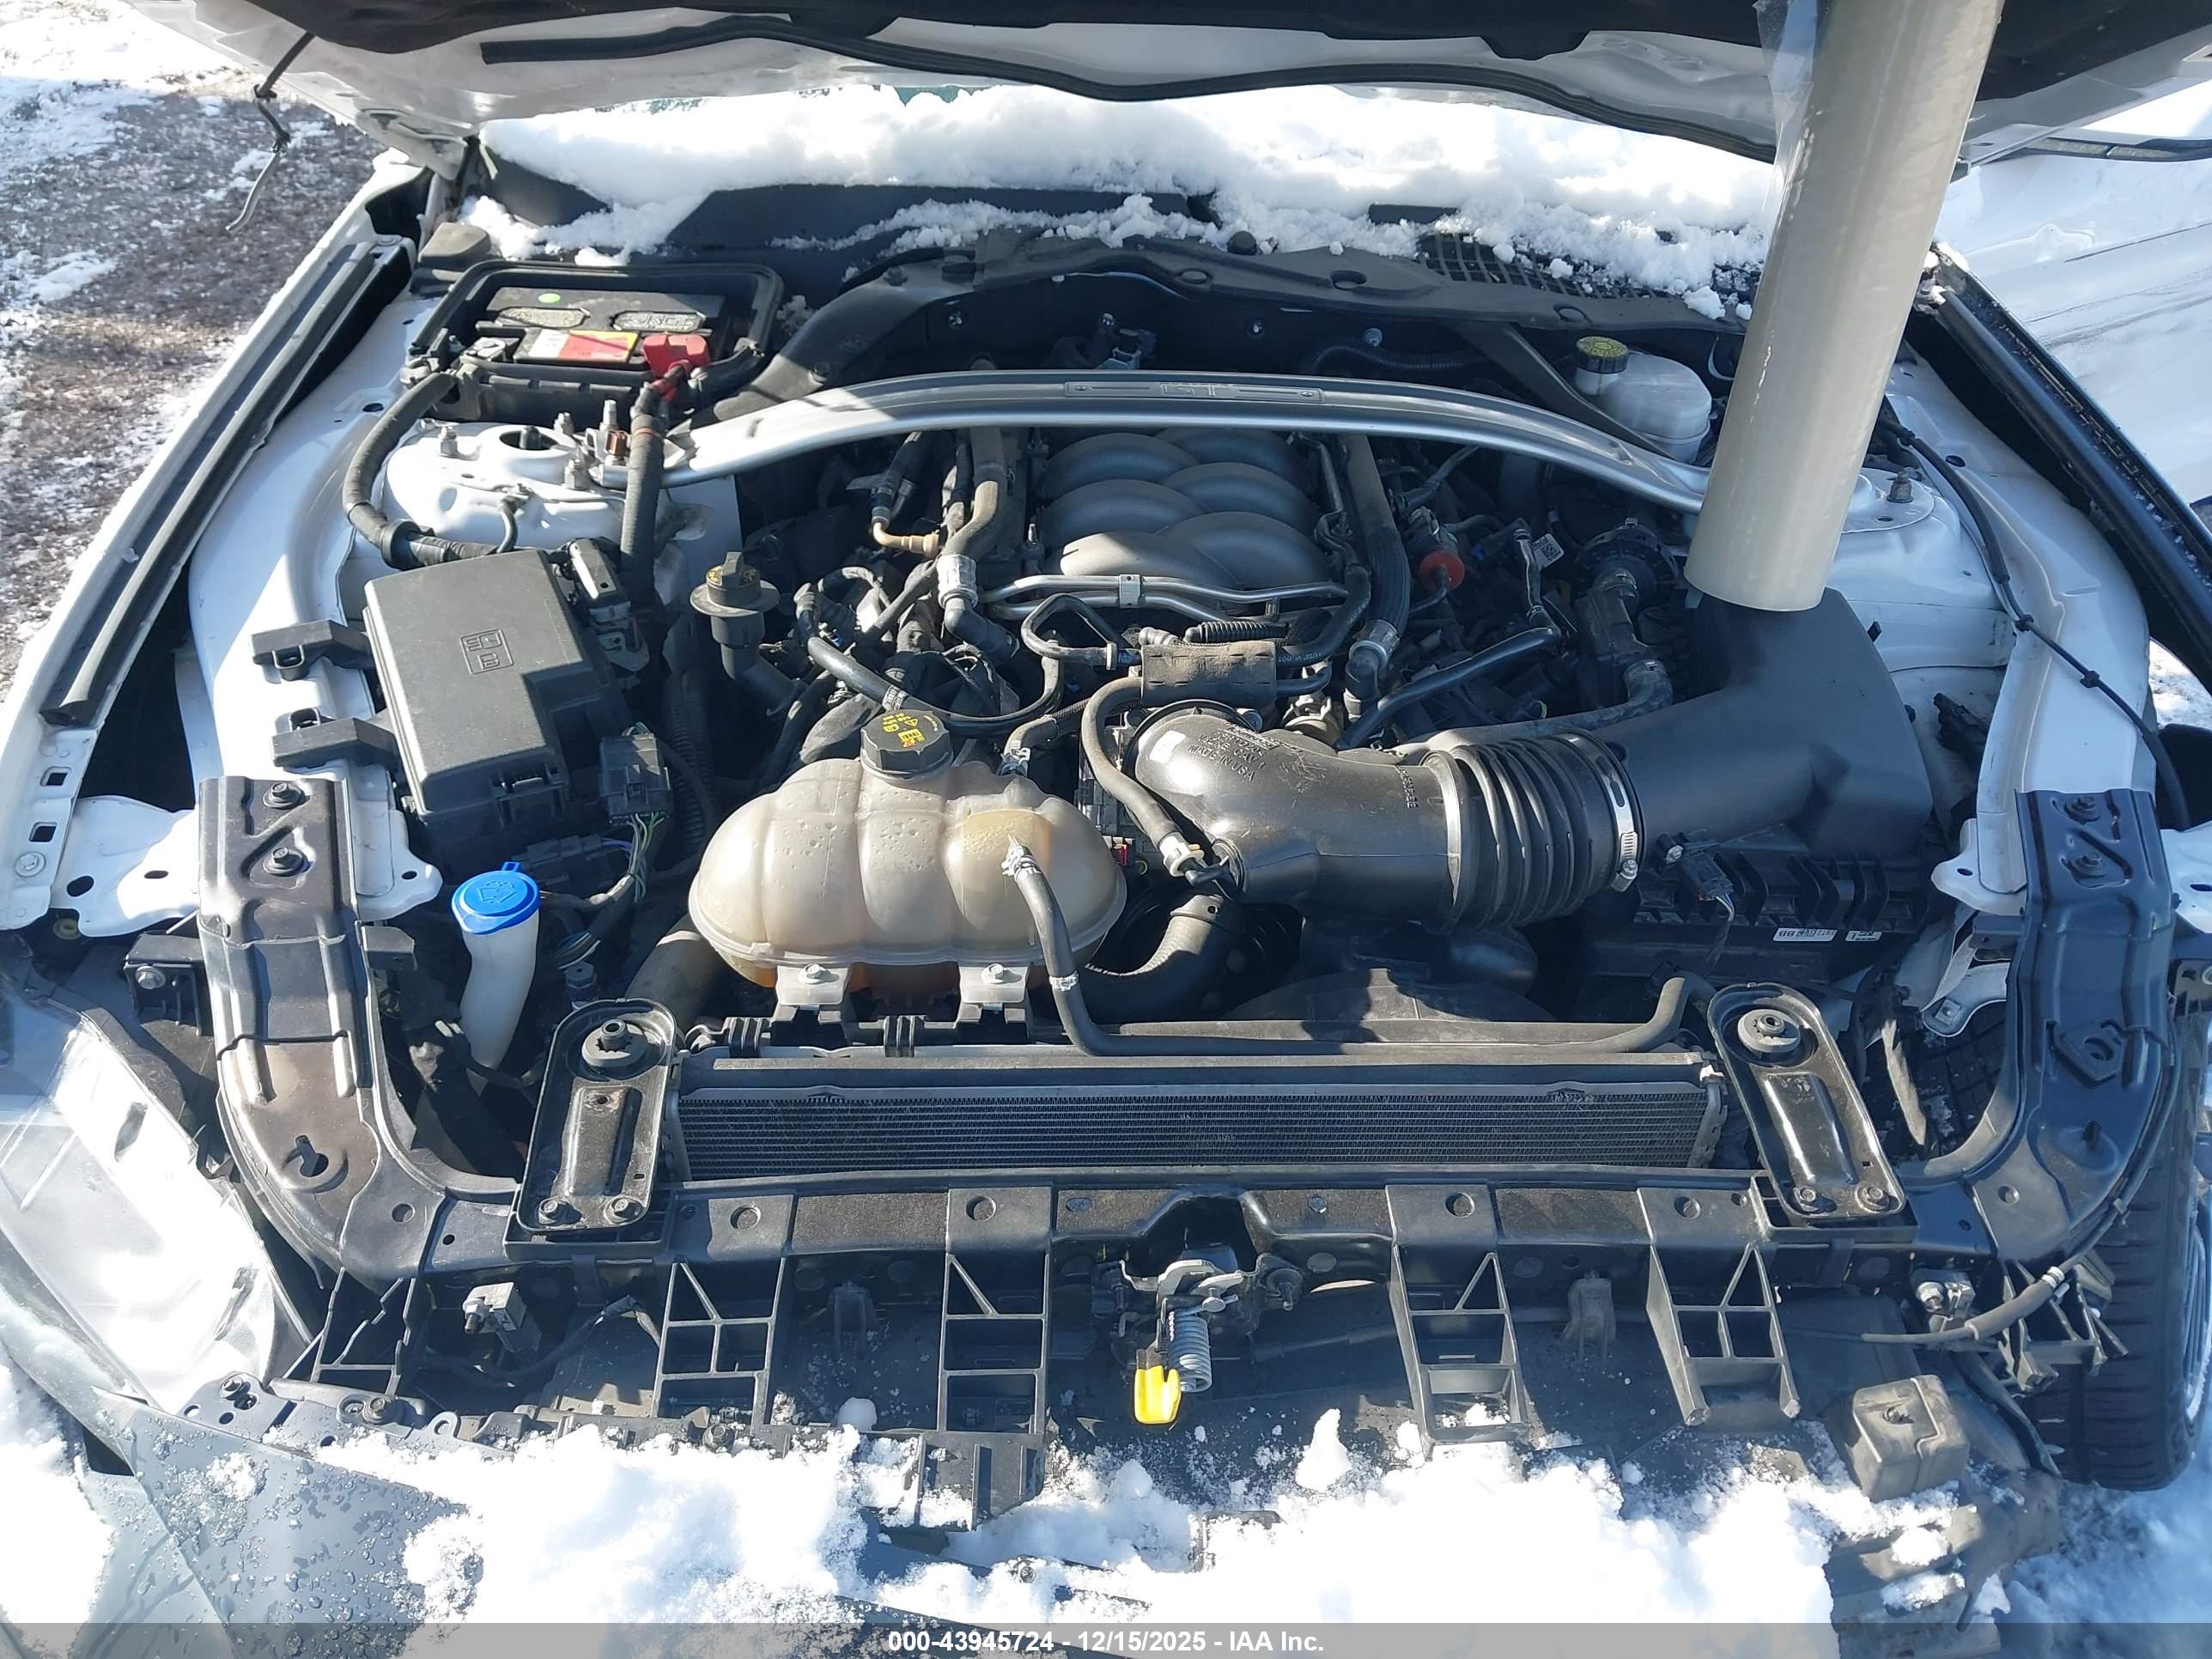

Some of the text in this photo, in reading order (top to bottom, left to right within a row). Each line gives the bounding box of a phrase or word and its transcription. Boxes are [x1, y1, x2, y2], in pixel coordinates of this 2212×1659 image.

[1160, 383, 1229, 397] GT
[1188, 744, 1255, 781] MADE IN USA
